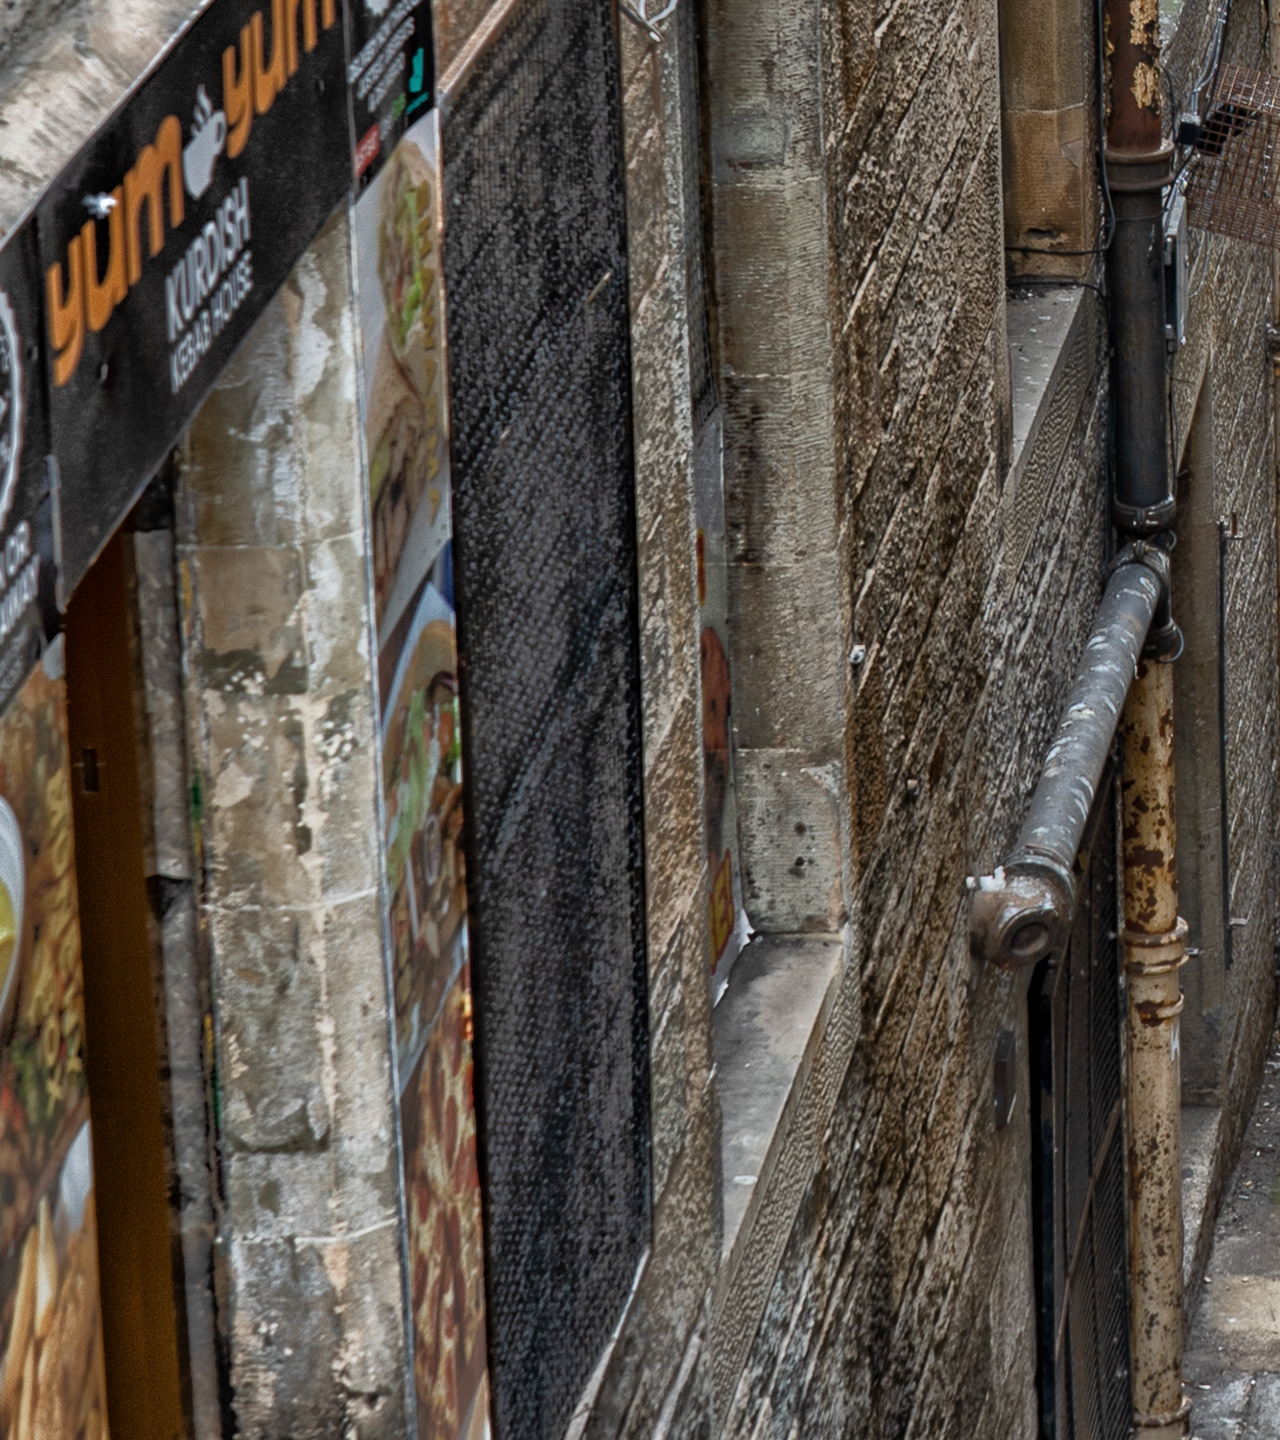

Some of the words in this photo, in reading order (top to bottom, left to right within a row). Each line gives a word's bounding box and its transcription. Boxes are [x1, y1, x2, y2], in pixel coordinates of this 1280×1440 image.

[45, 114, 186, 389] yum
[165, 176, 251, 343] KURDISH
[170, 309, 213, 395] KEBAB
[210, 249, 253, 336] HOUSE
